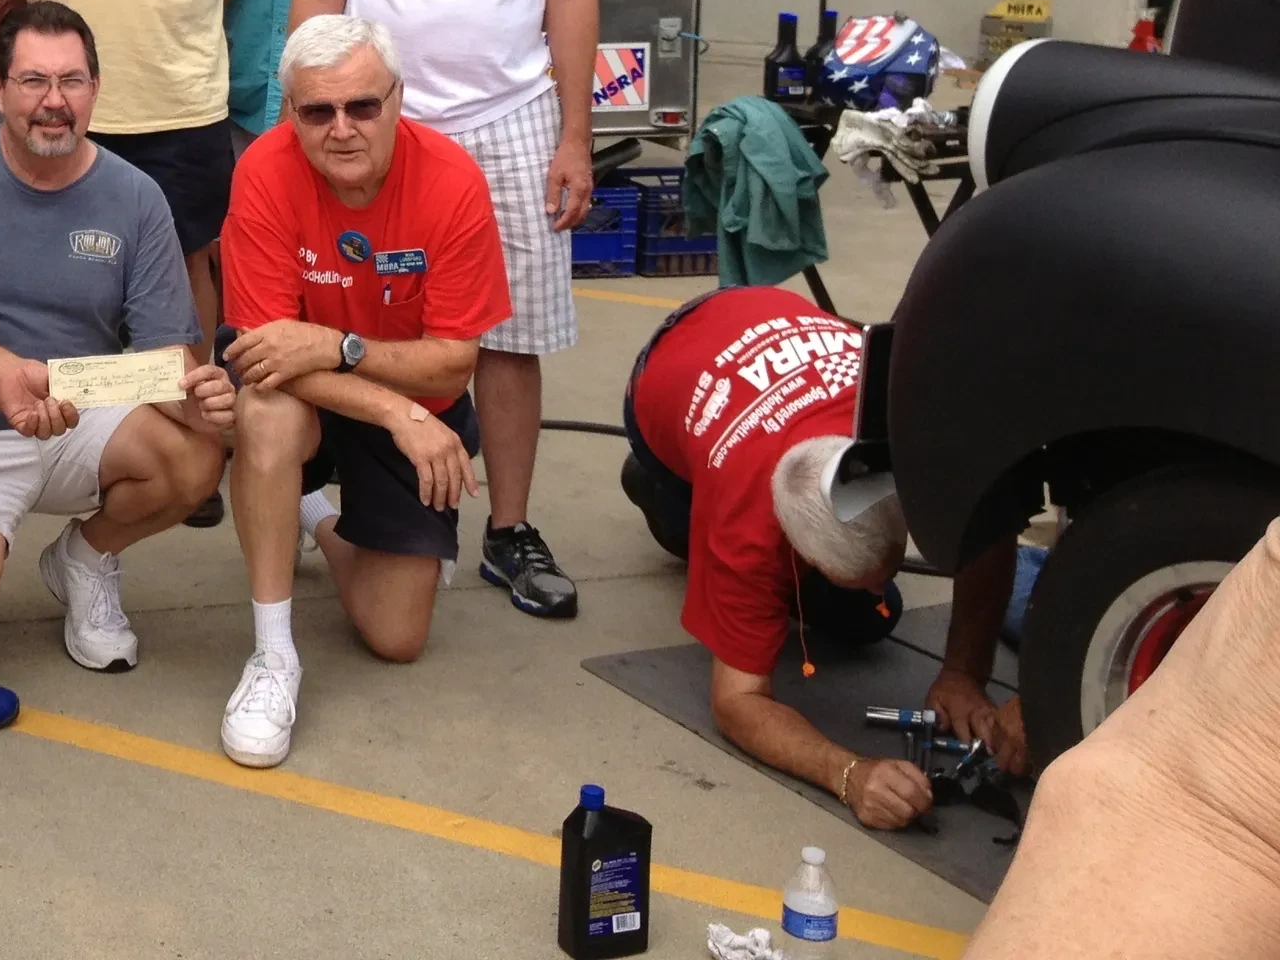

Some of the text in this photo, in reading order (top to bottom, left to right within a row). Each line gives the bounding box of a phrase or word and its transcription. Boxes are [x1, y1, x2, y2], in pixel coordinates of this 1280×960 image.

[1007, 3, 1044, 17] MHRA
[591, 67, 645, 106] NSRA
[713, 317, 792, 369] Repair
[737, 330, 863, 392] MHRA
[760, 386, 828, 435] Sponsored By
